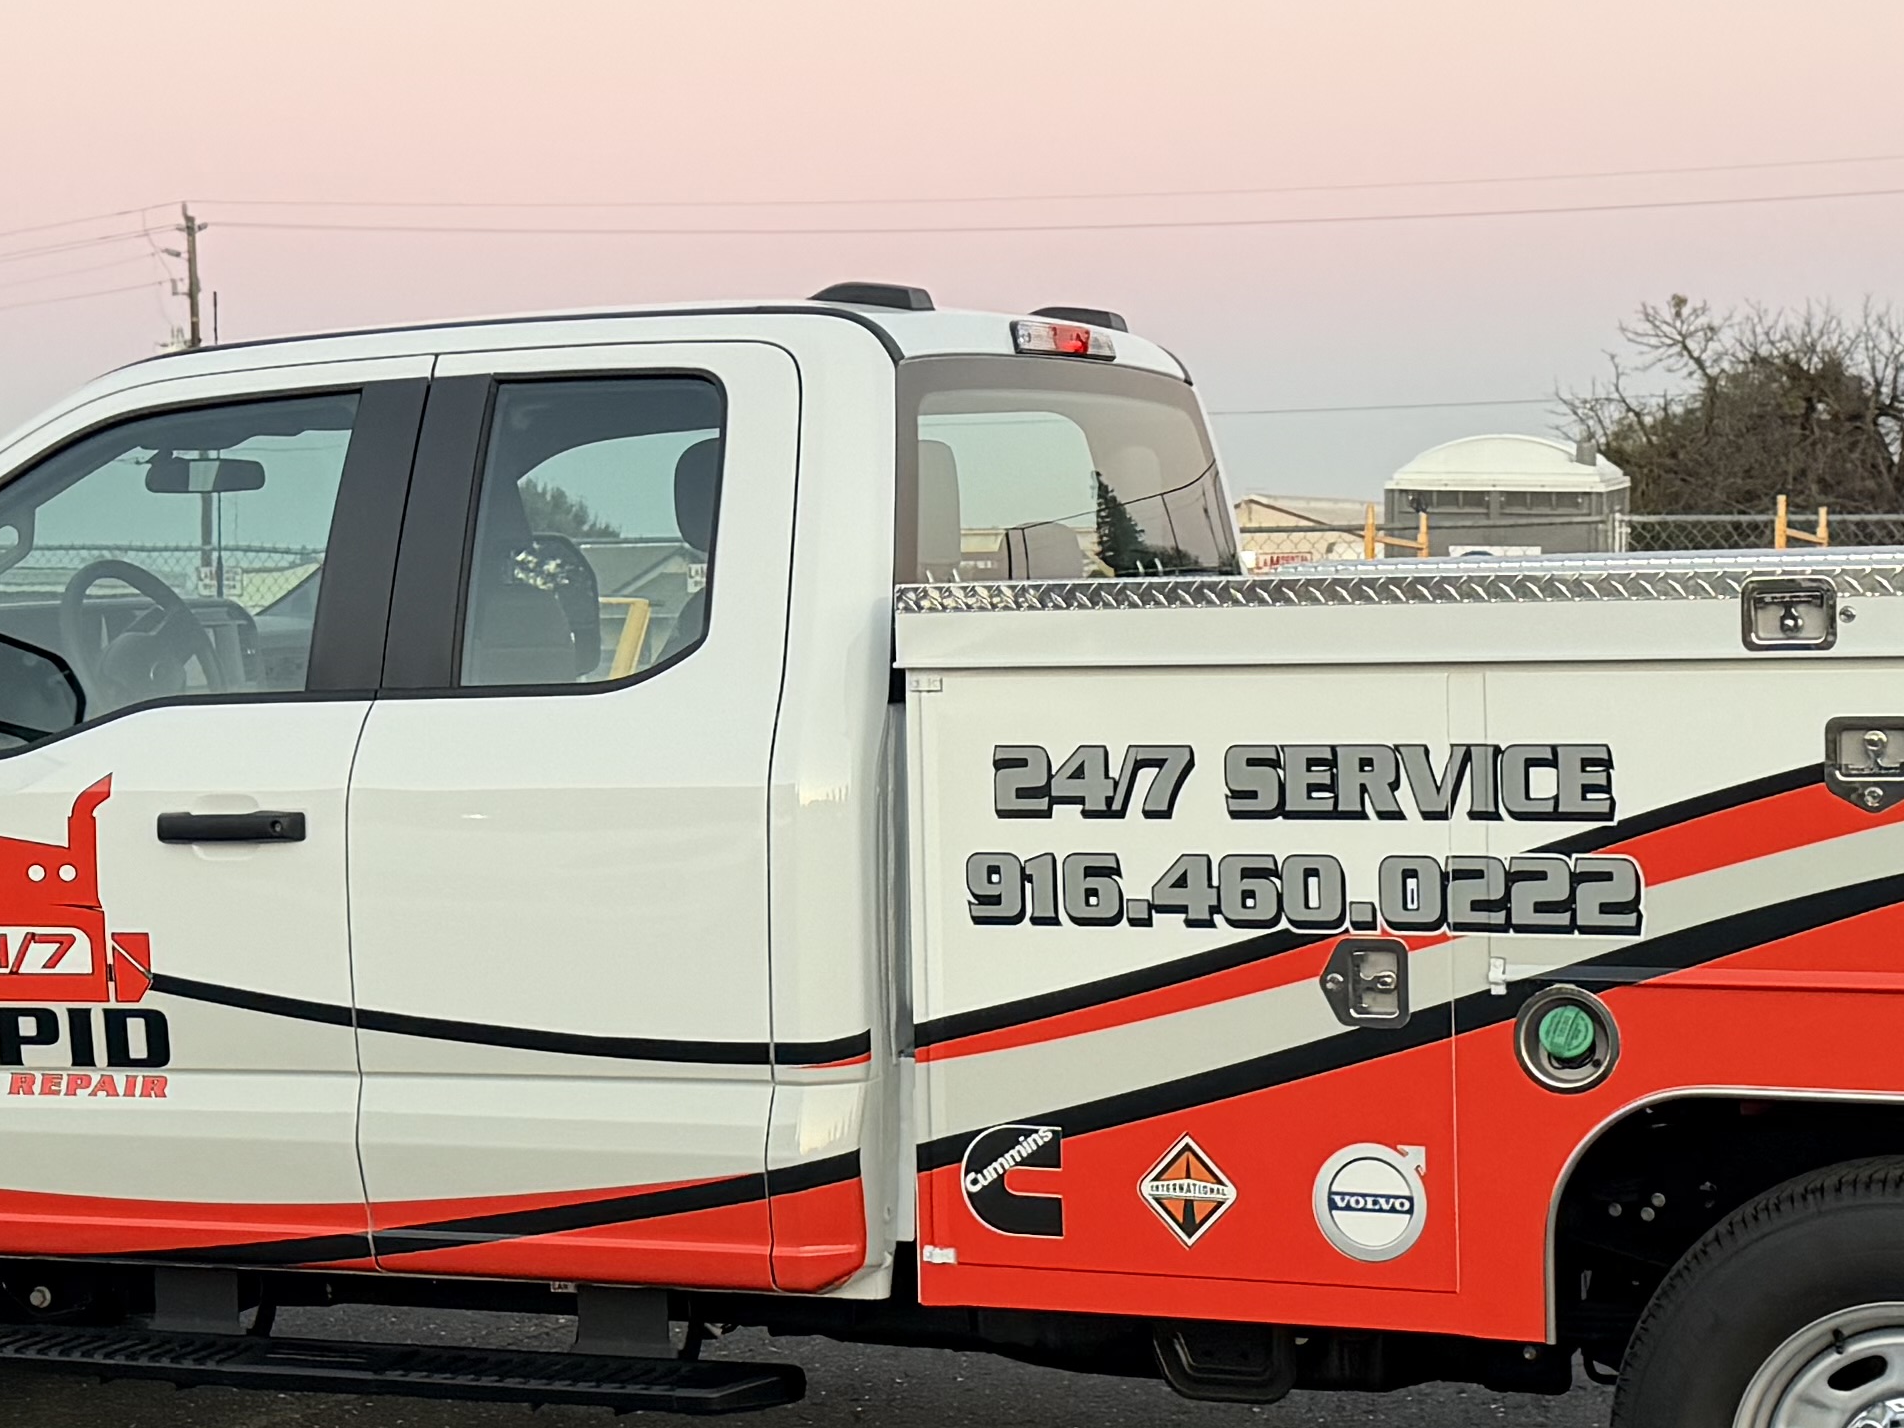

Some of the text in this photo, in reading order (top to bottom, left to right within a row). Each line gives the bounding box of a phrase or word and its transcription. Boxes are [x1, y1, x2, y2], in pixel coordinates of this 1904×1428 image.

[992, 743, 1618, 823] 24/7 SERVICE
[964, 851, 1646, 935] 916.460.0222
[8, 1072, 169, 1099] REPAIR
[964, 1127, 1053, 1193] Cummins
[1149, 1181, 1229, 1197] INTERNATIONAL
[1331, 1194, 1411, 1211] VOLVO
